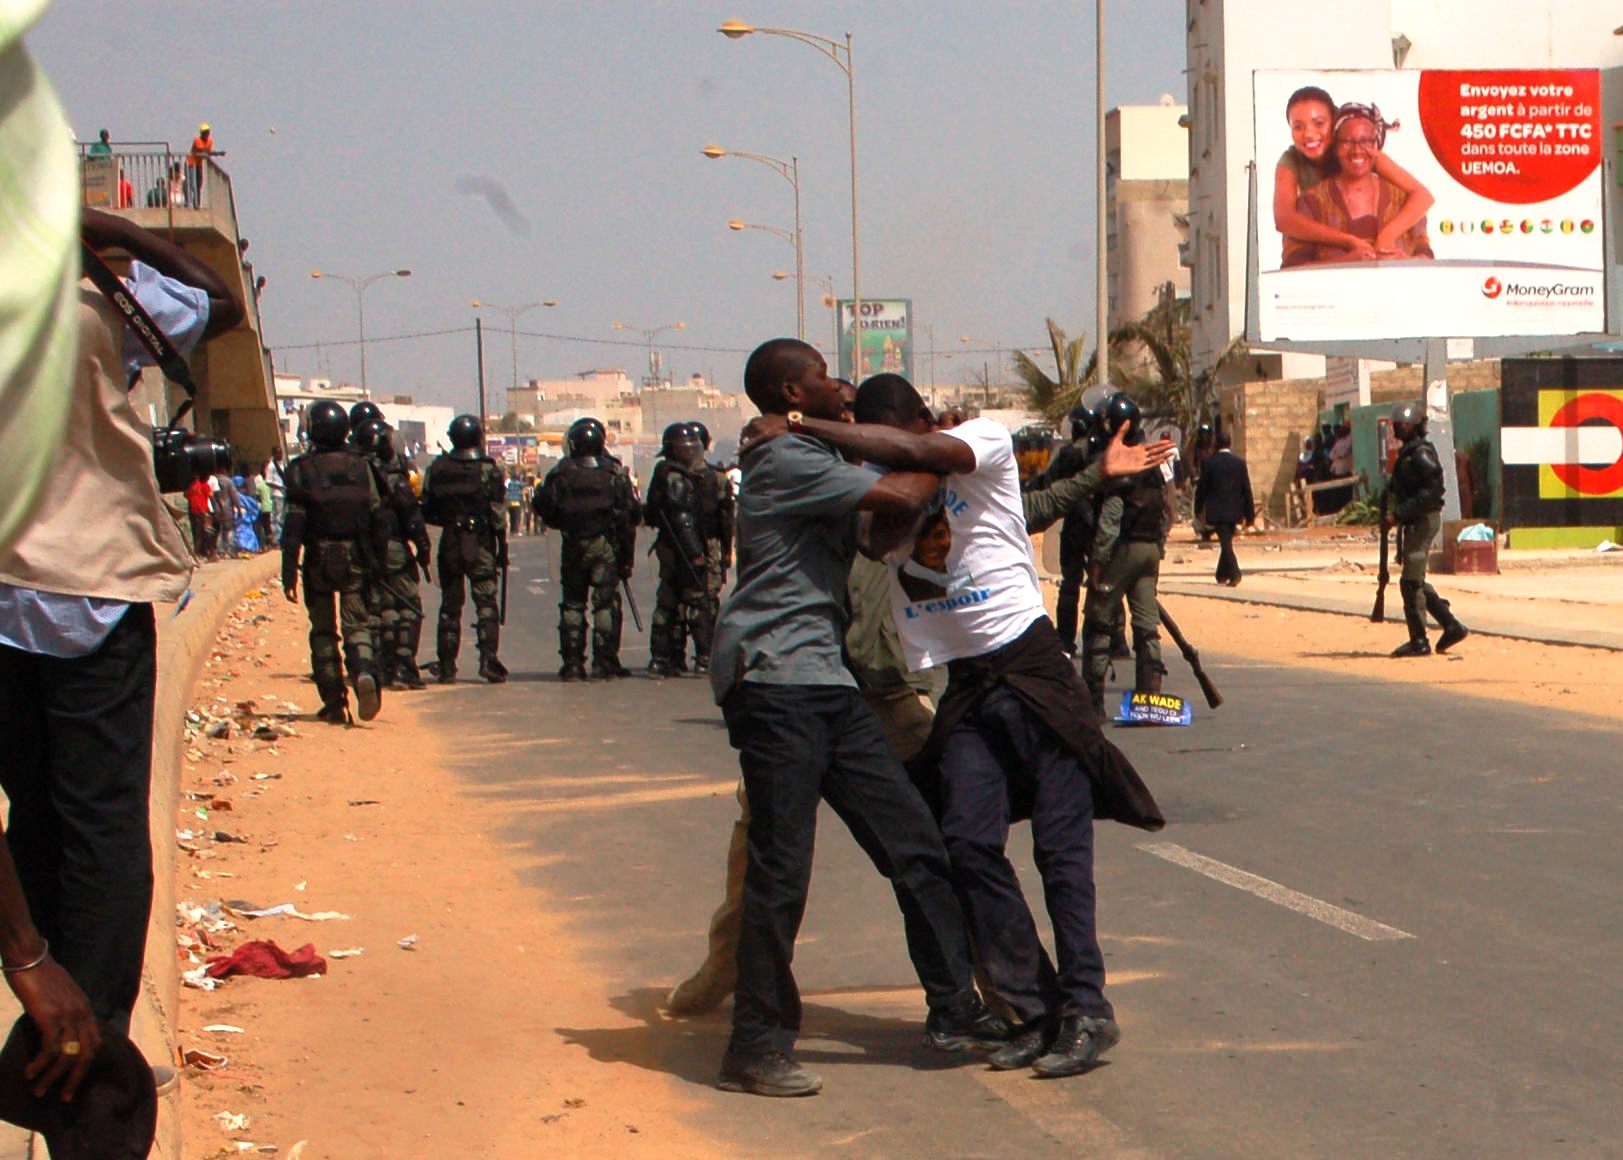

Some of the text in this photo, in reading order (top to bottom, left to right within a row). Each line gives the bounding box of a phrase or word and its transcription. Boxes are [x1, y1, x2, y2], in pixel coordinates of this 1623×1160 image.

[1460, 84, 1574, 99] Envoyez votre
[1460, 103, 1593, 119] argent à partir de
[1460, 124, 1496, 139] 450
[1556, 124, 1592, 139] TTC
[1461, 142, 1590, 155] dans toute la zone
[1461, 161, 1521, 175] UEMOA.
[1506, 283, 1594, 298] MoneyGram
[114, 291, 164, 356] EOS DIGITAL
[1149, 695, 1182, 710] WADE
